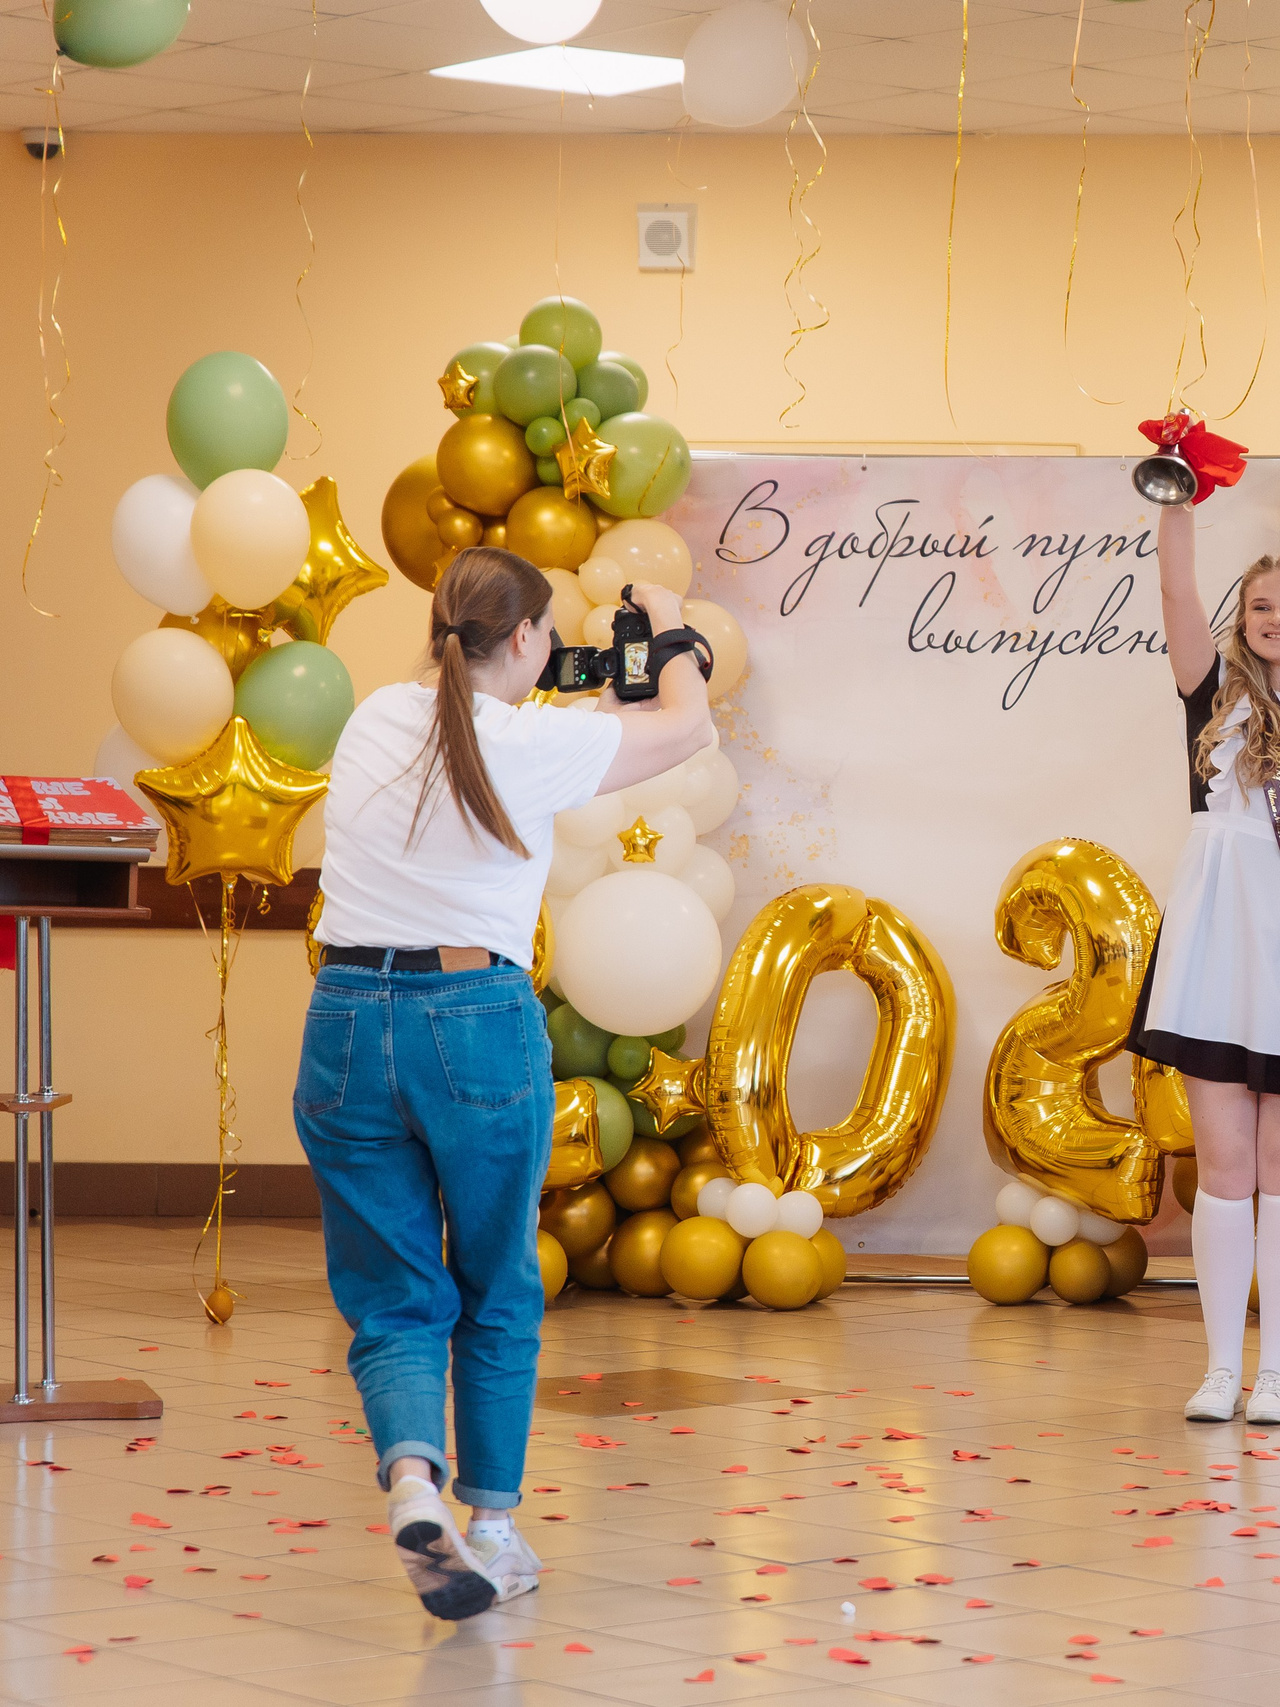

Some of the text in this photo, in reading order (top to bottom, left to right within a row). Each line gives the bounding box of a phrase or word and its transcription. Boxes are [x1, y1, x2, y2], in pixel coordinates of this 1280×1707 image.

[715, 480, 1161, 616] В добрый пут
[907, 571, 1244, 710] выпускн
